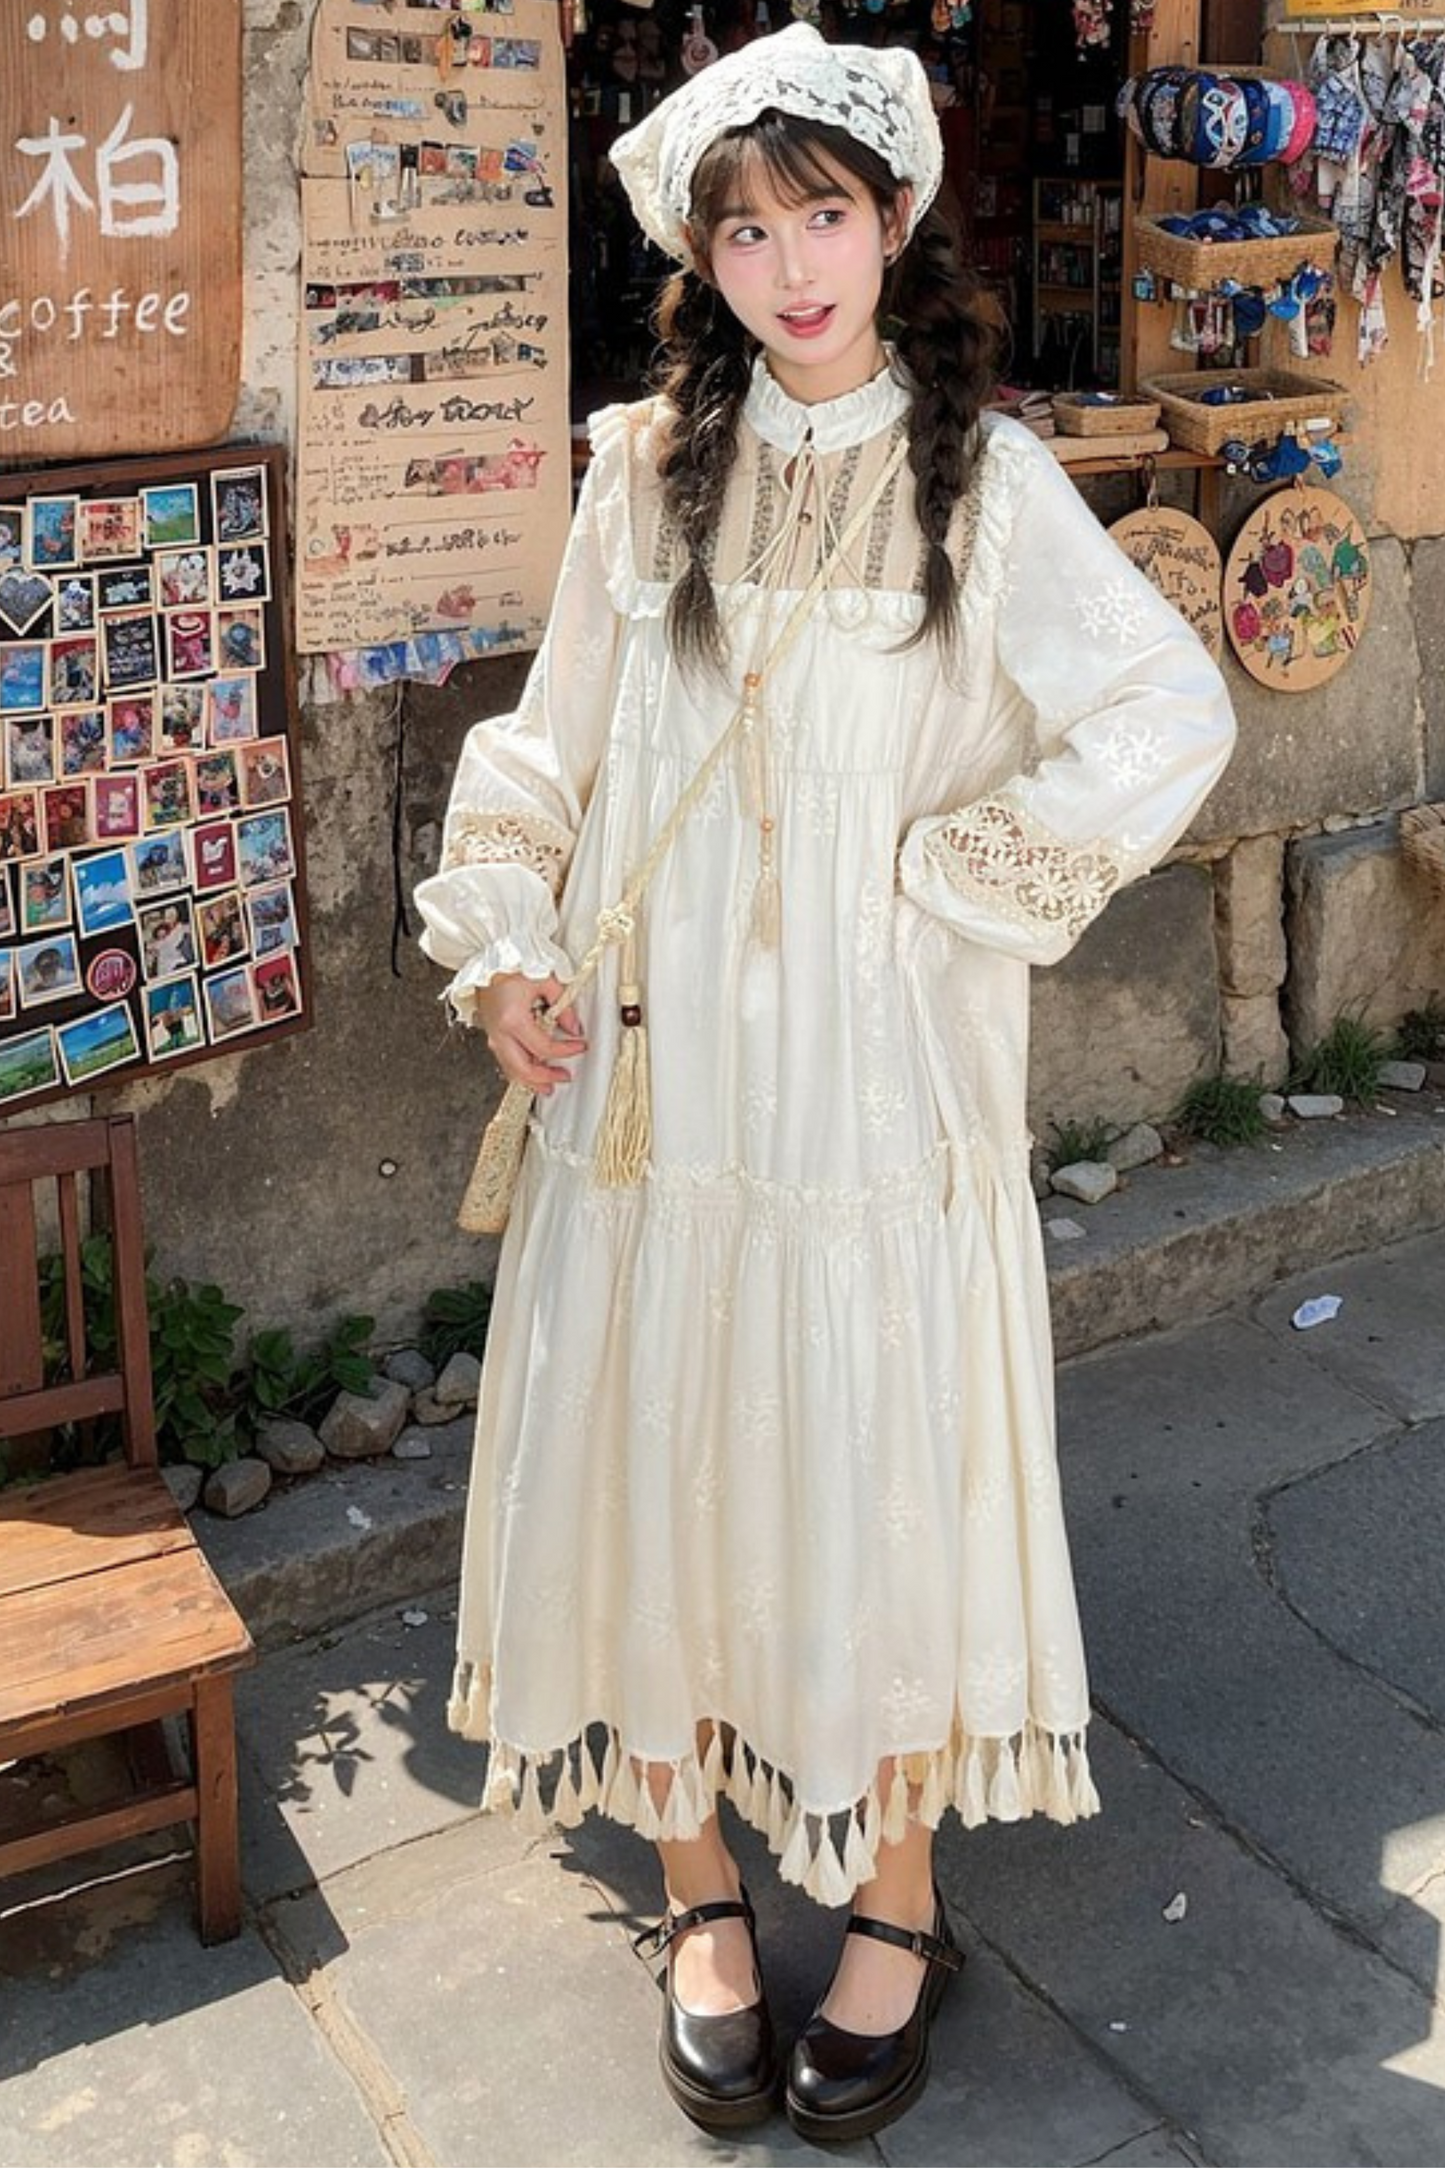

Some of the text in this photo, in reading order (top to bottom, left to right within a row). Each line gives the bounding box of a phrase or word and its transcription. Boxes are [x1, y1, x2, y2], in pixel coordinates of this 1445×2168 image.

[14, 101, 181, 270] 柏
[0, 287, 190, 340] coffee
[0, 396, 75, 430] tea
